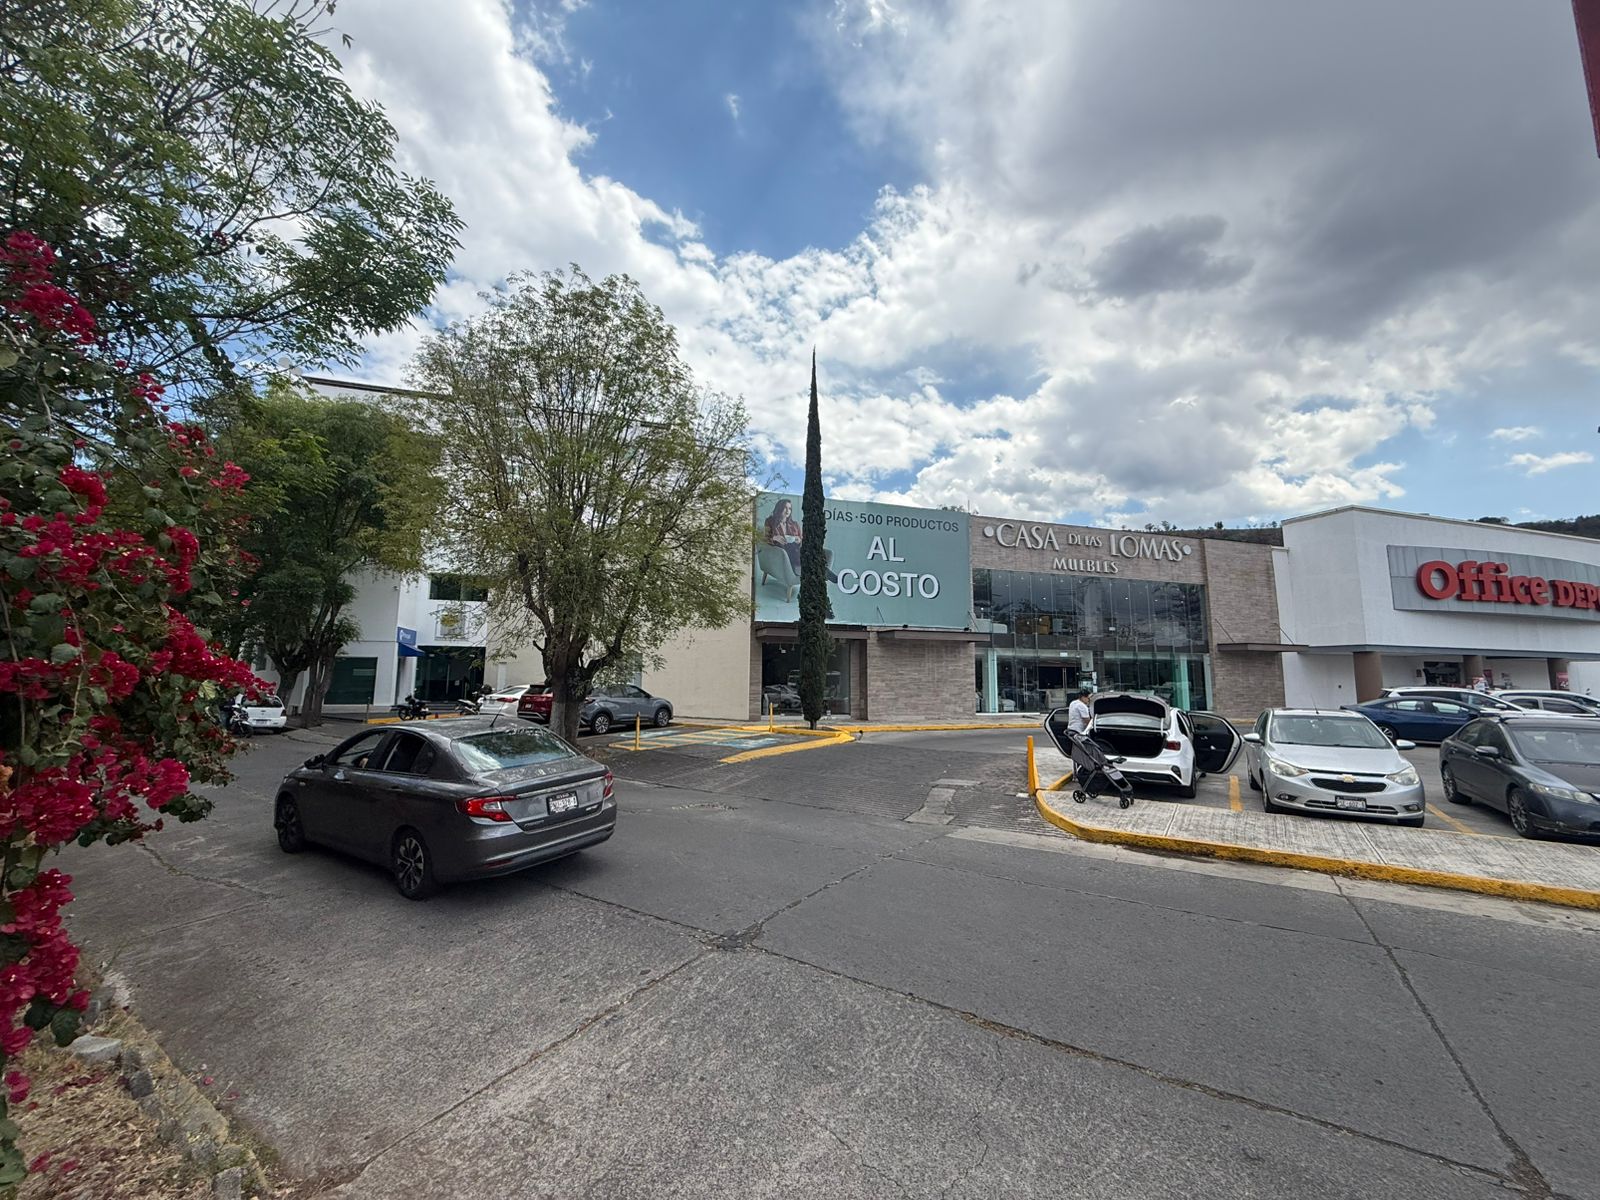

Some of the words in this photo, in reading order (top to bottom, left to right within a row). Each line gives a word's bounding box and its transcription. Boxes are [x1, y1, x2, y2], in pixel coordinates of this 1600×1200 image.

[886, 515, 959, 532] PRODUCTOS
[867, 536, 905, 563] AL
[996, 523, 1060, 551] CASA
[1110, 533, 1183, 562] LOMAS
[1053, 557, 1119, 574] MUEBLES
[837, 568, 941, 599] COSTO
[1416, 560, 1549, 605] Office
[1549, 579, 1600, 611] DEP
